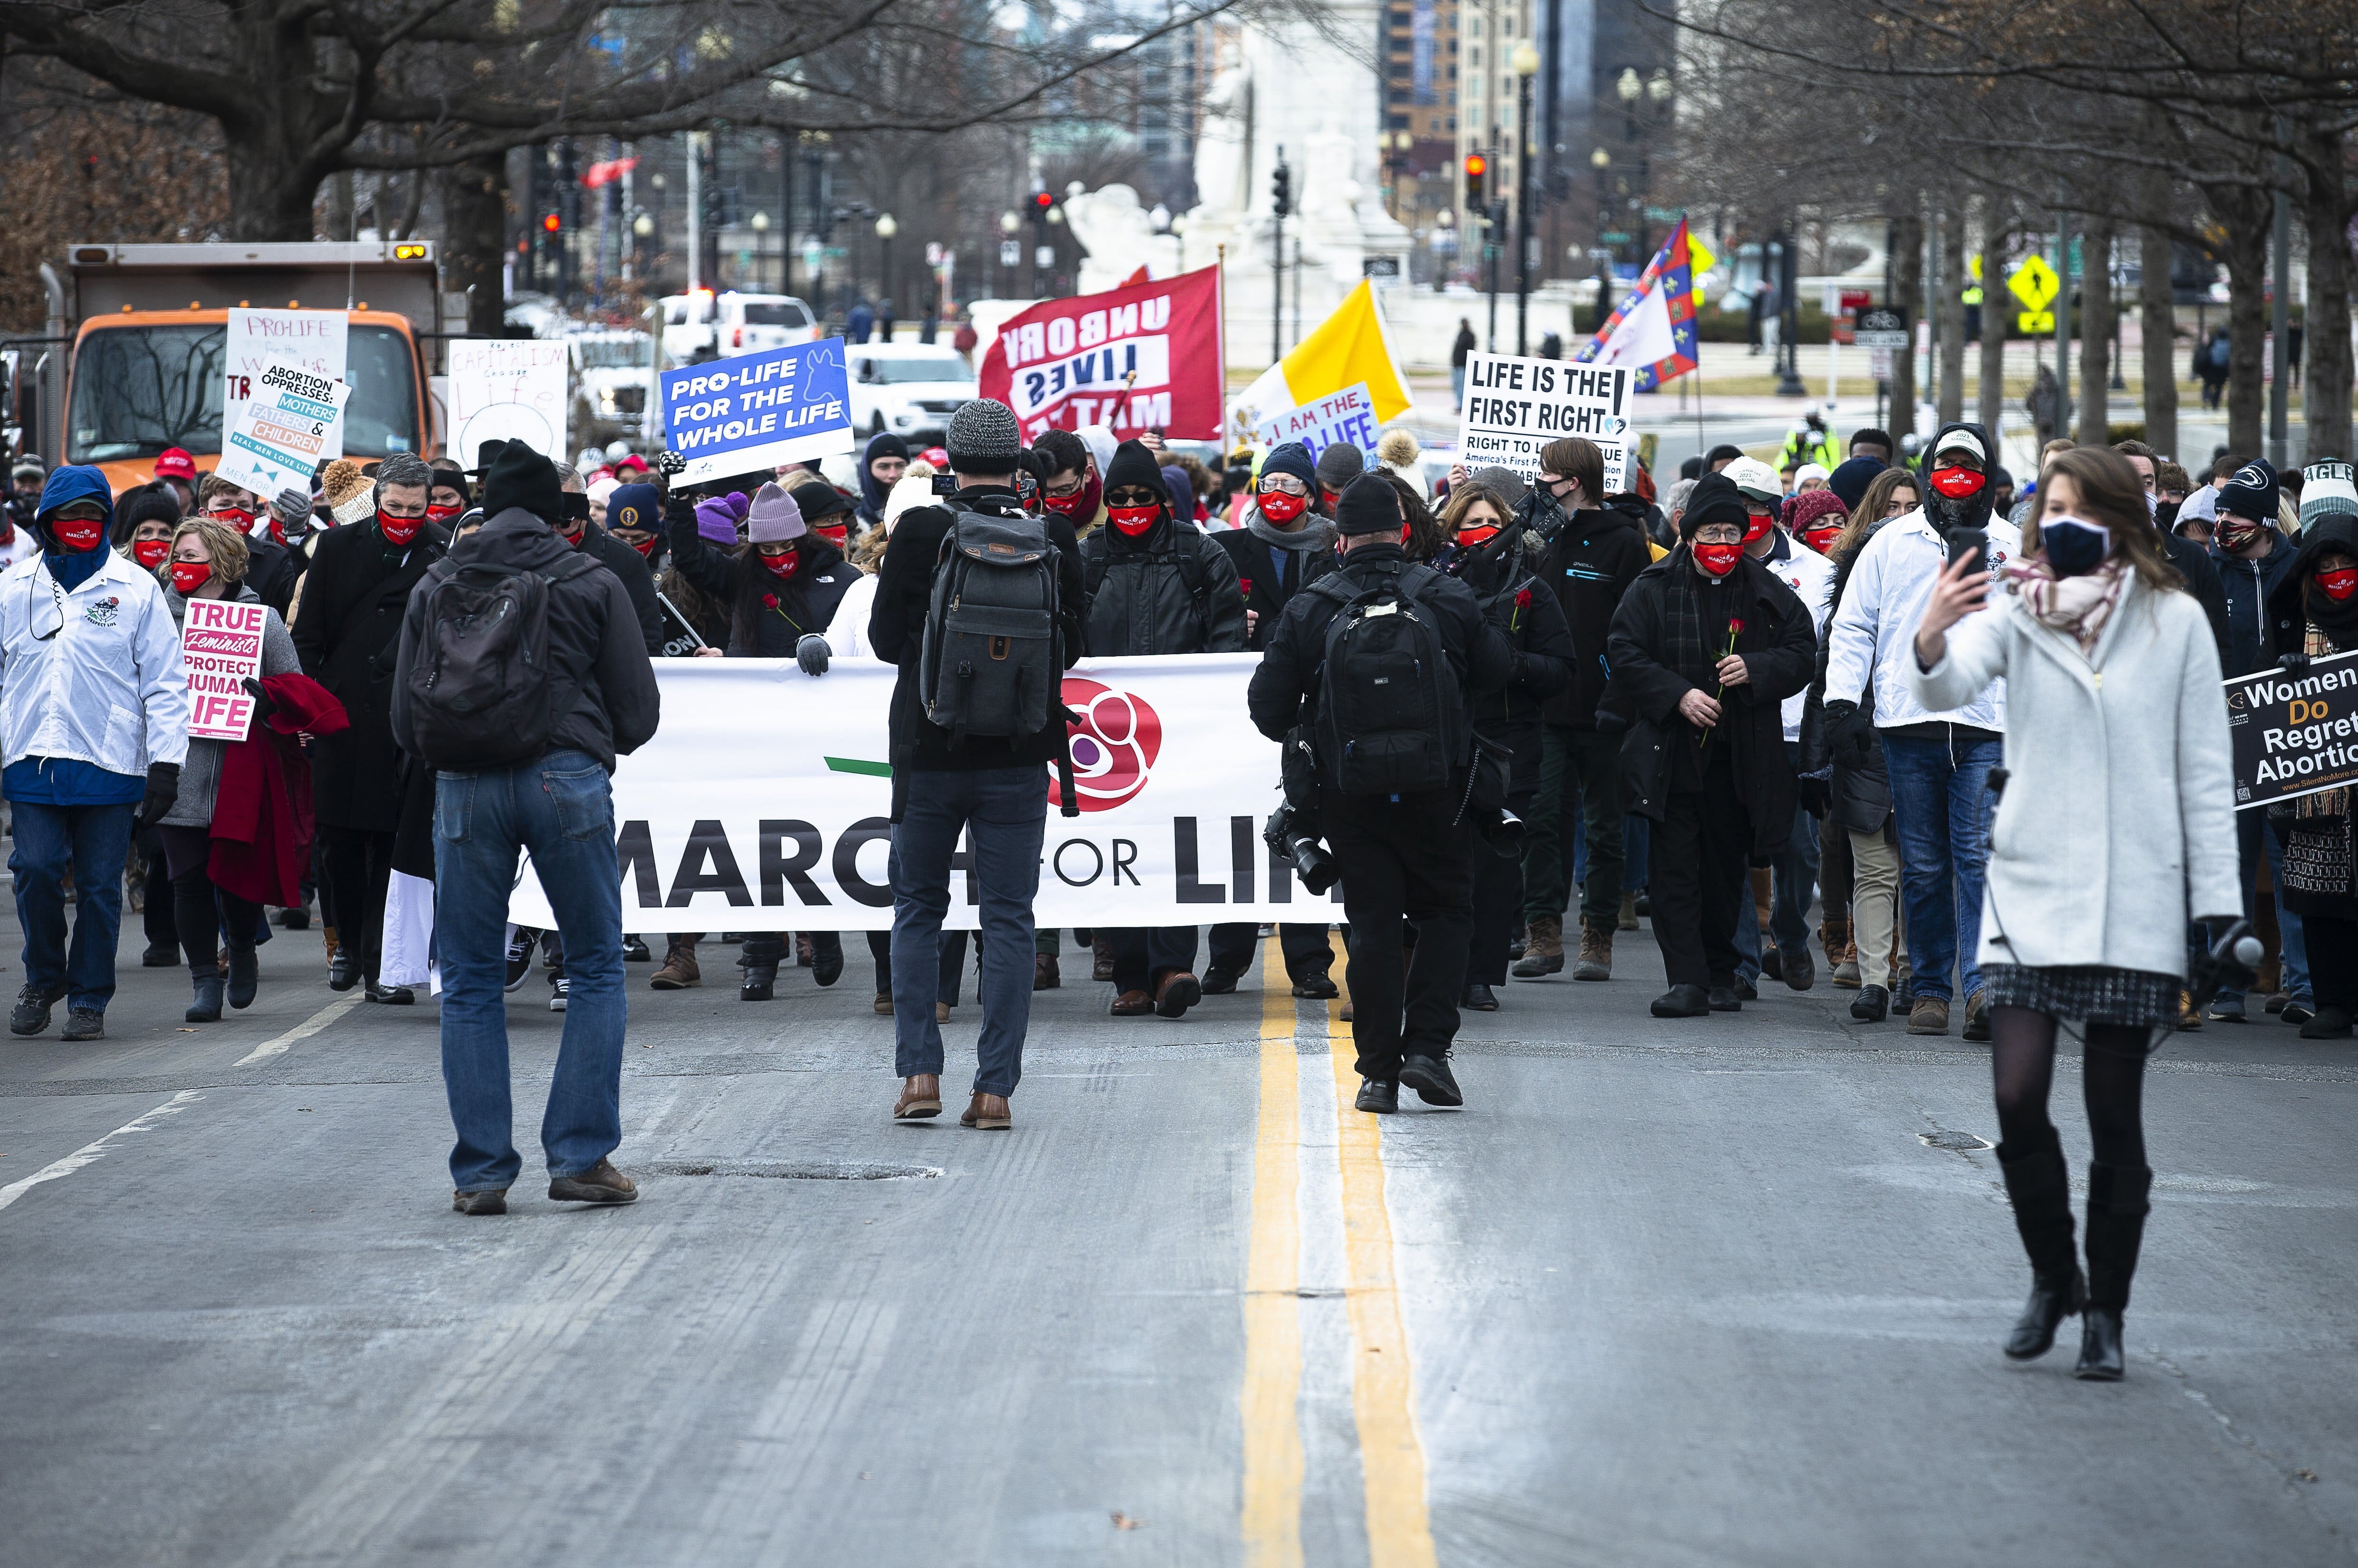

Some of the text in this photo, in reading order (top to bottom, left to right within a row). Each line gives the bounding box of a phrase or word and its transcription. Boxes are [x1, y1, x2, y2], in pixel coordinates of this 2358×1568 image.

[248, 316, 331, 337] PRO-LIFE
[453, 348, 568, 371] CAPITALISM
[261, 374, 333, 404] OPPRESSES:
[268, 365, 333, 392] ABORTION
[671, 358, 797, 401] PRO-LIFE
[1472, 360, 1524, 390] LIFE
[1532, 366, 1555, 393] IS
[1564, 368, 1612, 398] THE
[279, 395, 335, 421] MOTHERS
[457, 375, 554, 421] Life
[673, 384, 794, 426] FOR THE
[252, 405, 323, 436] FATHERS &
[676, 400, 842, 450] WHOLE LIFE
[1273, 391, 1359, 439] I AM THE
[1470, 397, 1606, 434] FIRST RIGHT
[254, 423, 321, 452] CHILDREN
[1467, 436, 1509, 451] RIGHT
[1513, 440, 1530, 453] TO
[233, 435, 313, 474] REAL MEN LOVE LIFE
[1465, 452, 1507, 465] America's
[1510, 457, 1529, 466] First
[225, 467, 247, 483] MEN
[249, 478, 269, 493] FOR
[387, 526, 403, 537] MARCH
[1708, 555, 1725, 564] MARCH
[86, 616, 106, 627] RESPECT
[191, 602, 262, 631] TRUE
[185, 631, 258, 654] Feminists
[2243, 667, 2357, 708] Women
[193, 696, 250, 727] IFE
[2289, 699, 2329, 725] Do
[2263, 710, 2358, 754] Regret
[2256, 742, 2358, 784] Abortio
[2282, 768, 2358, 791] www.SilentNoMore.co
[1054, 838, 1141, 886] OR
